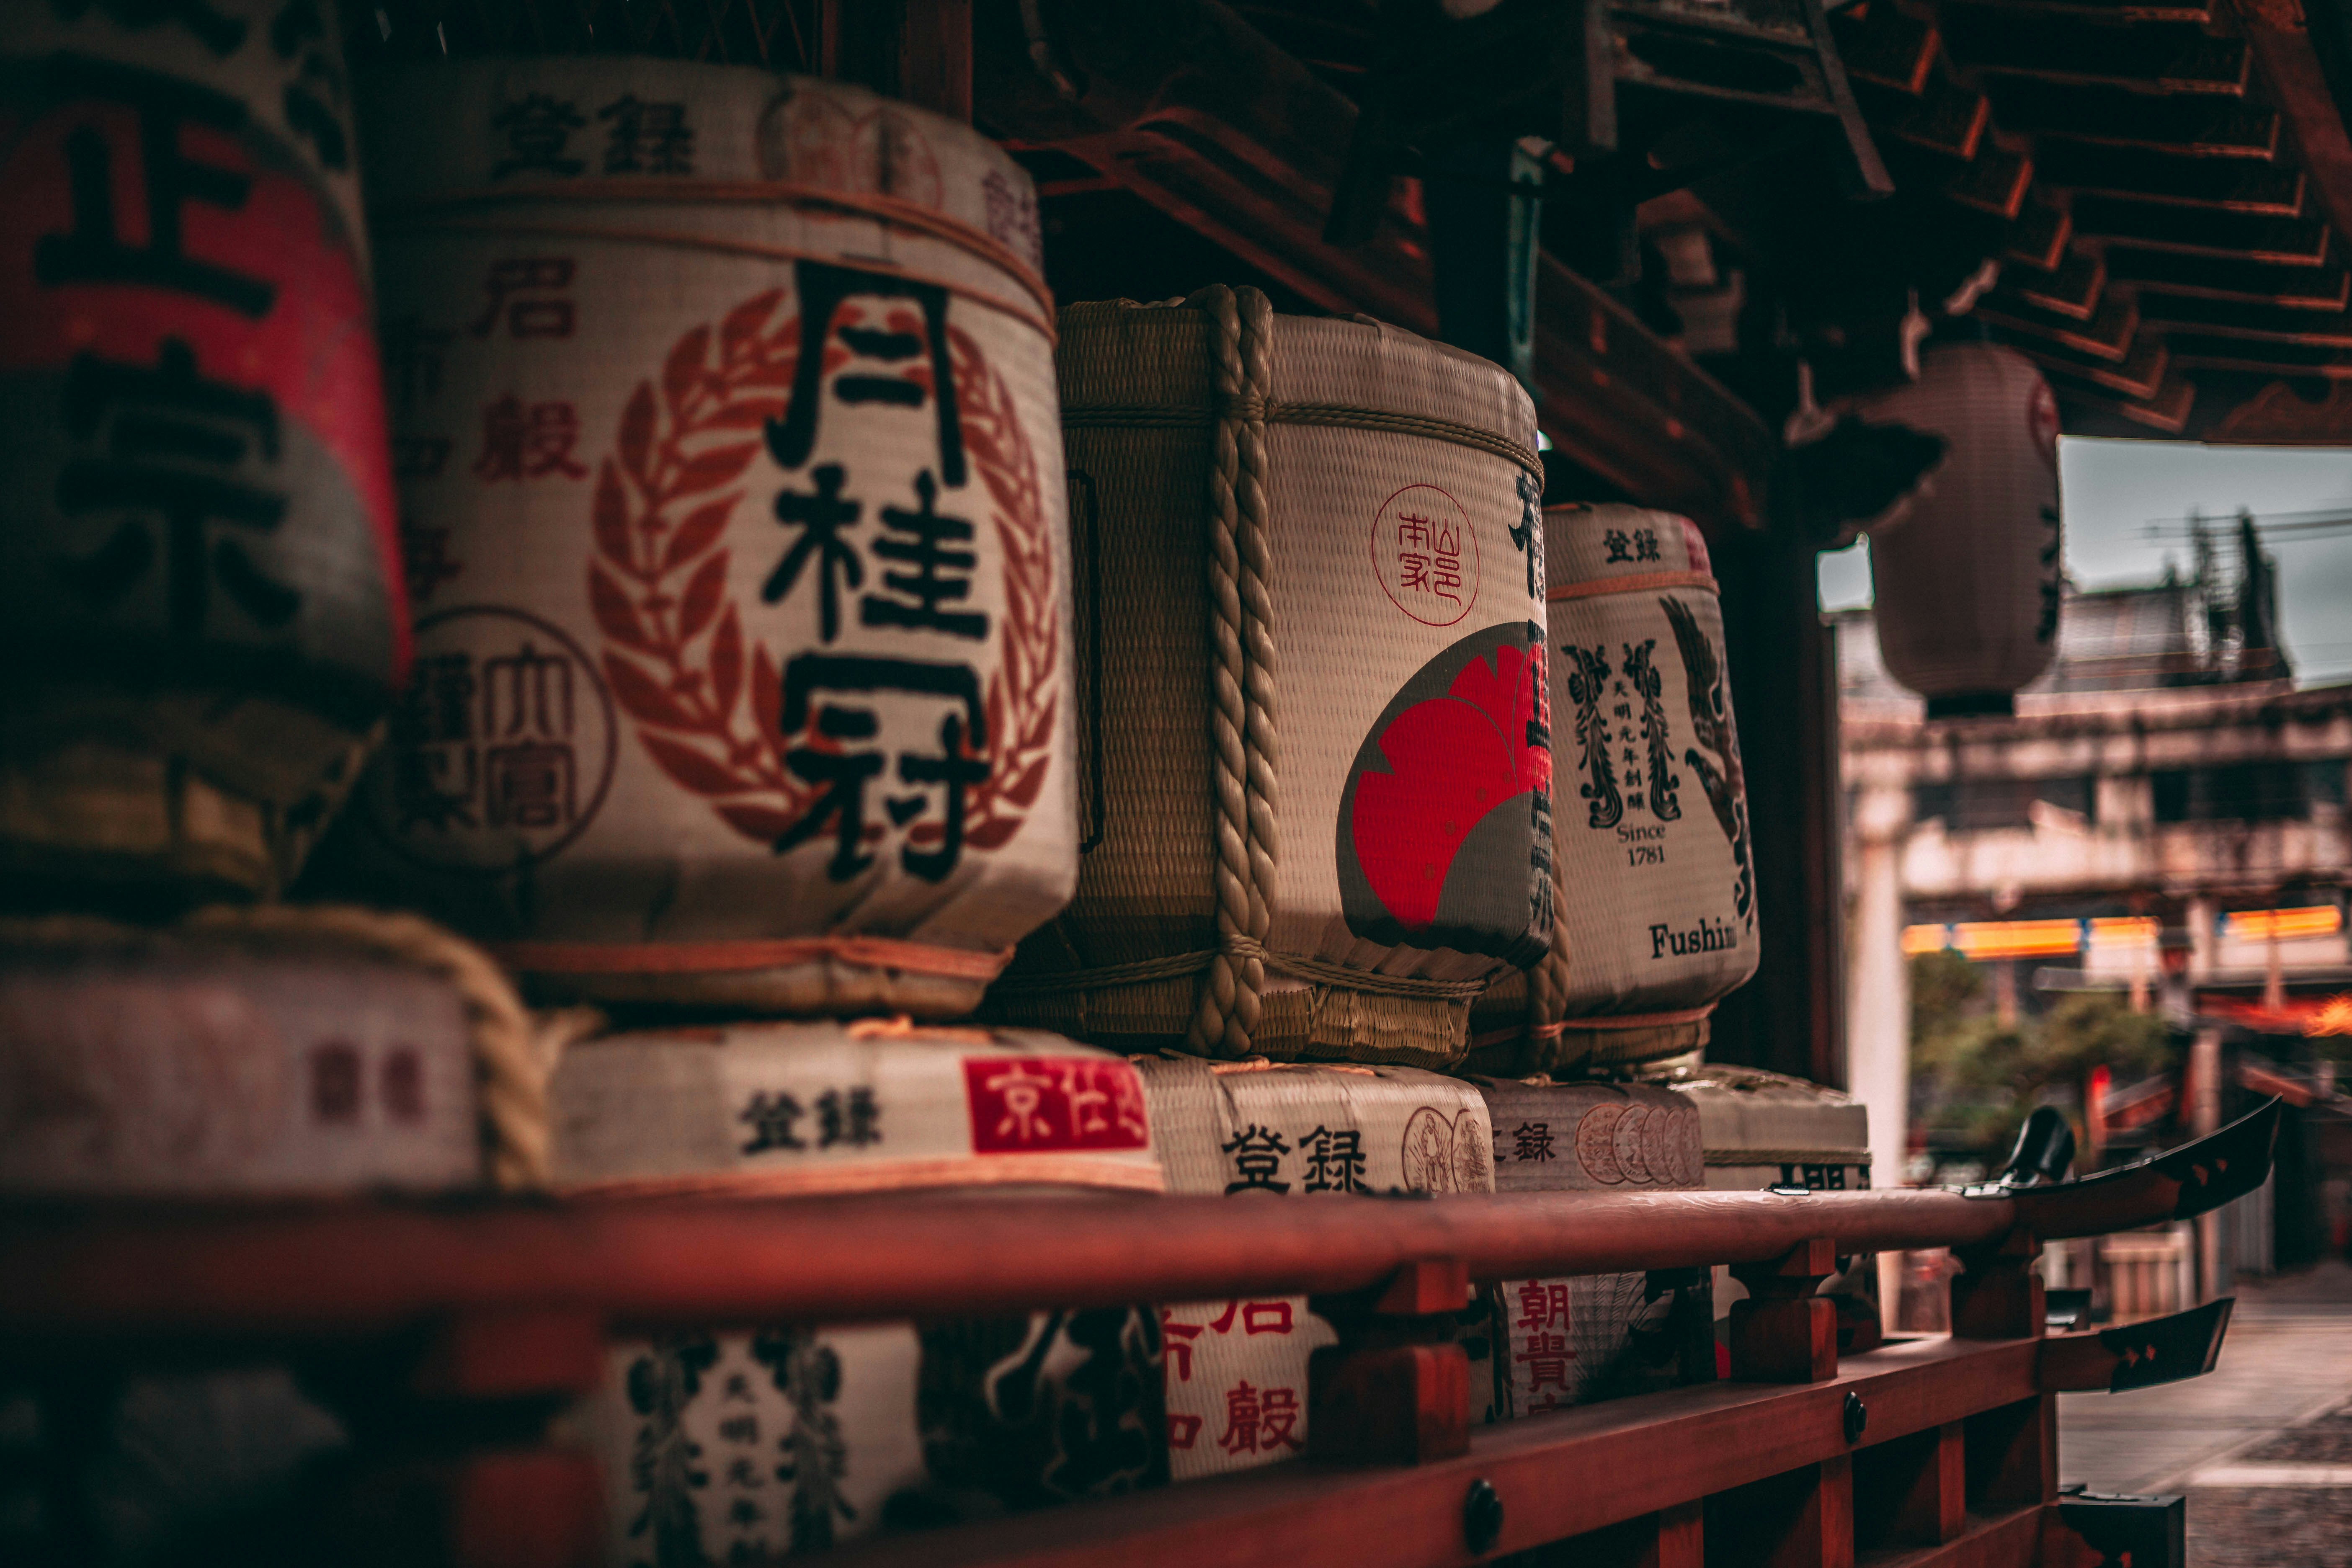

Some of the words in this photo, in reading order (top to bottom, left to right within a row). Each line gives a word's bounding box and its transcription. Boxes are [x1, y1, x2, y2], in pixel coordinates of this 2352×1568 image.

[765, 259, 989, 879] 月桂冠
[1603, 529, 1660, 563] 登録
[1617, 821, 1666, 843] Since
[1627, 845, 1665, 866] 1781
[1221, 1124, 1367, 1194] 登録
[1515, 1279, 1577, 1415] 朝貴
